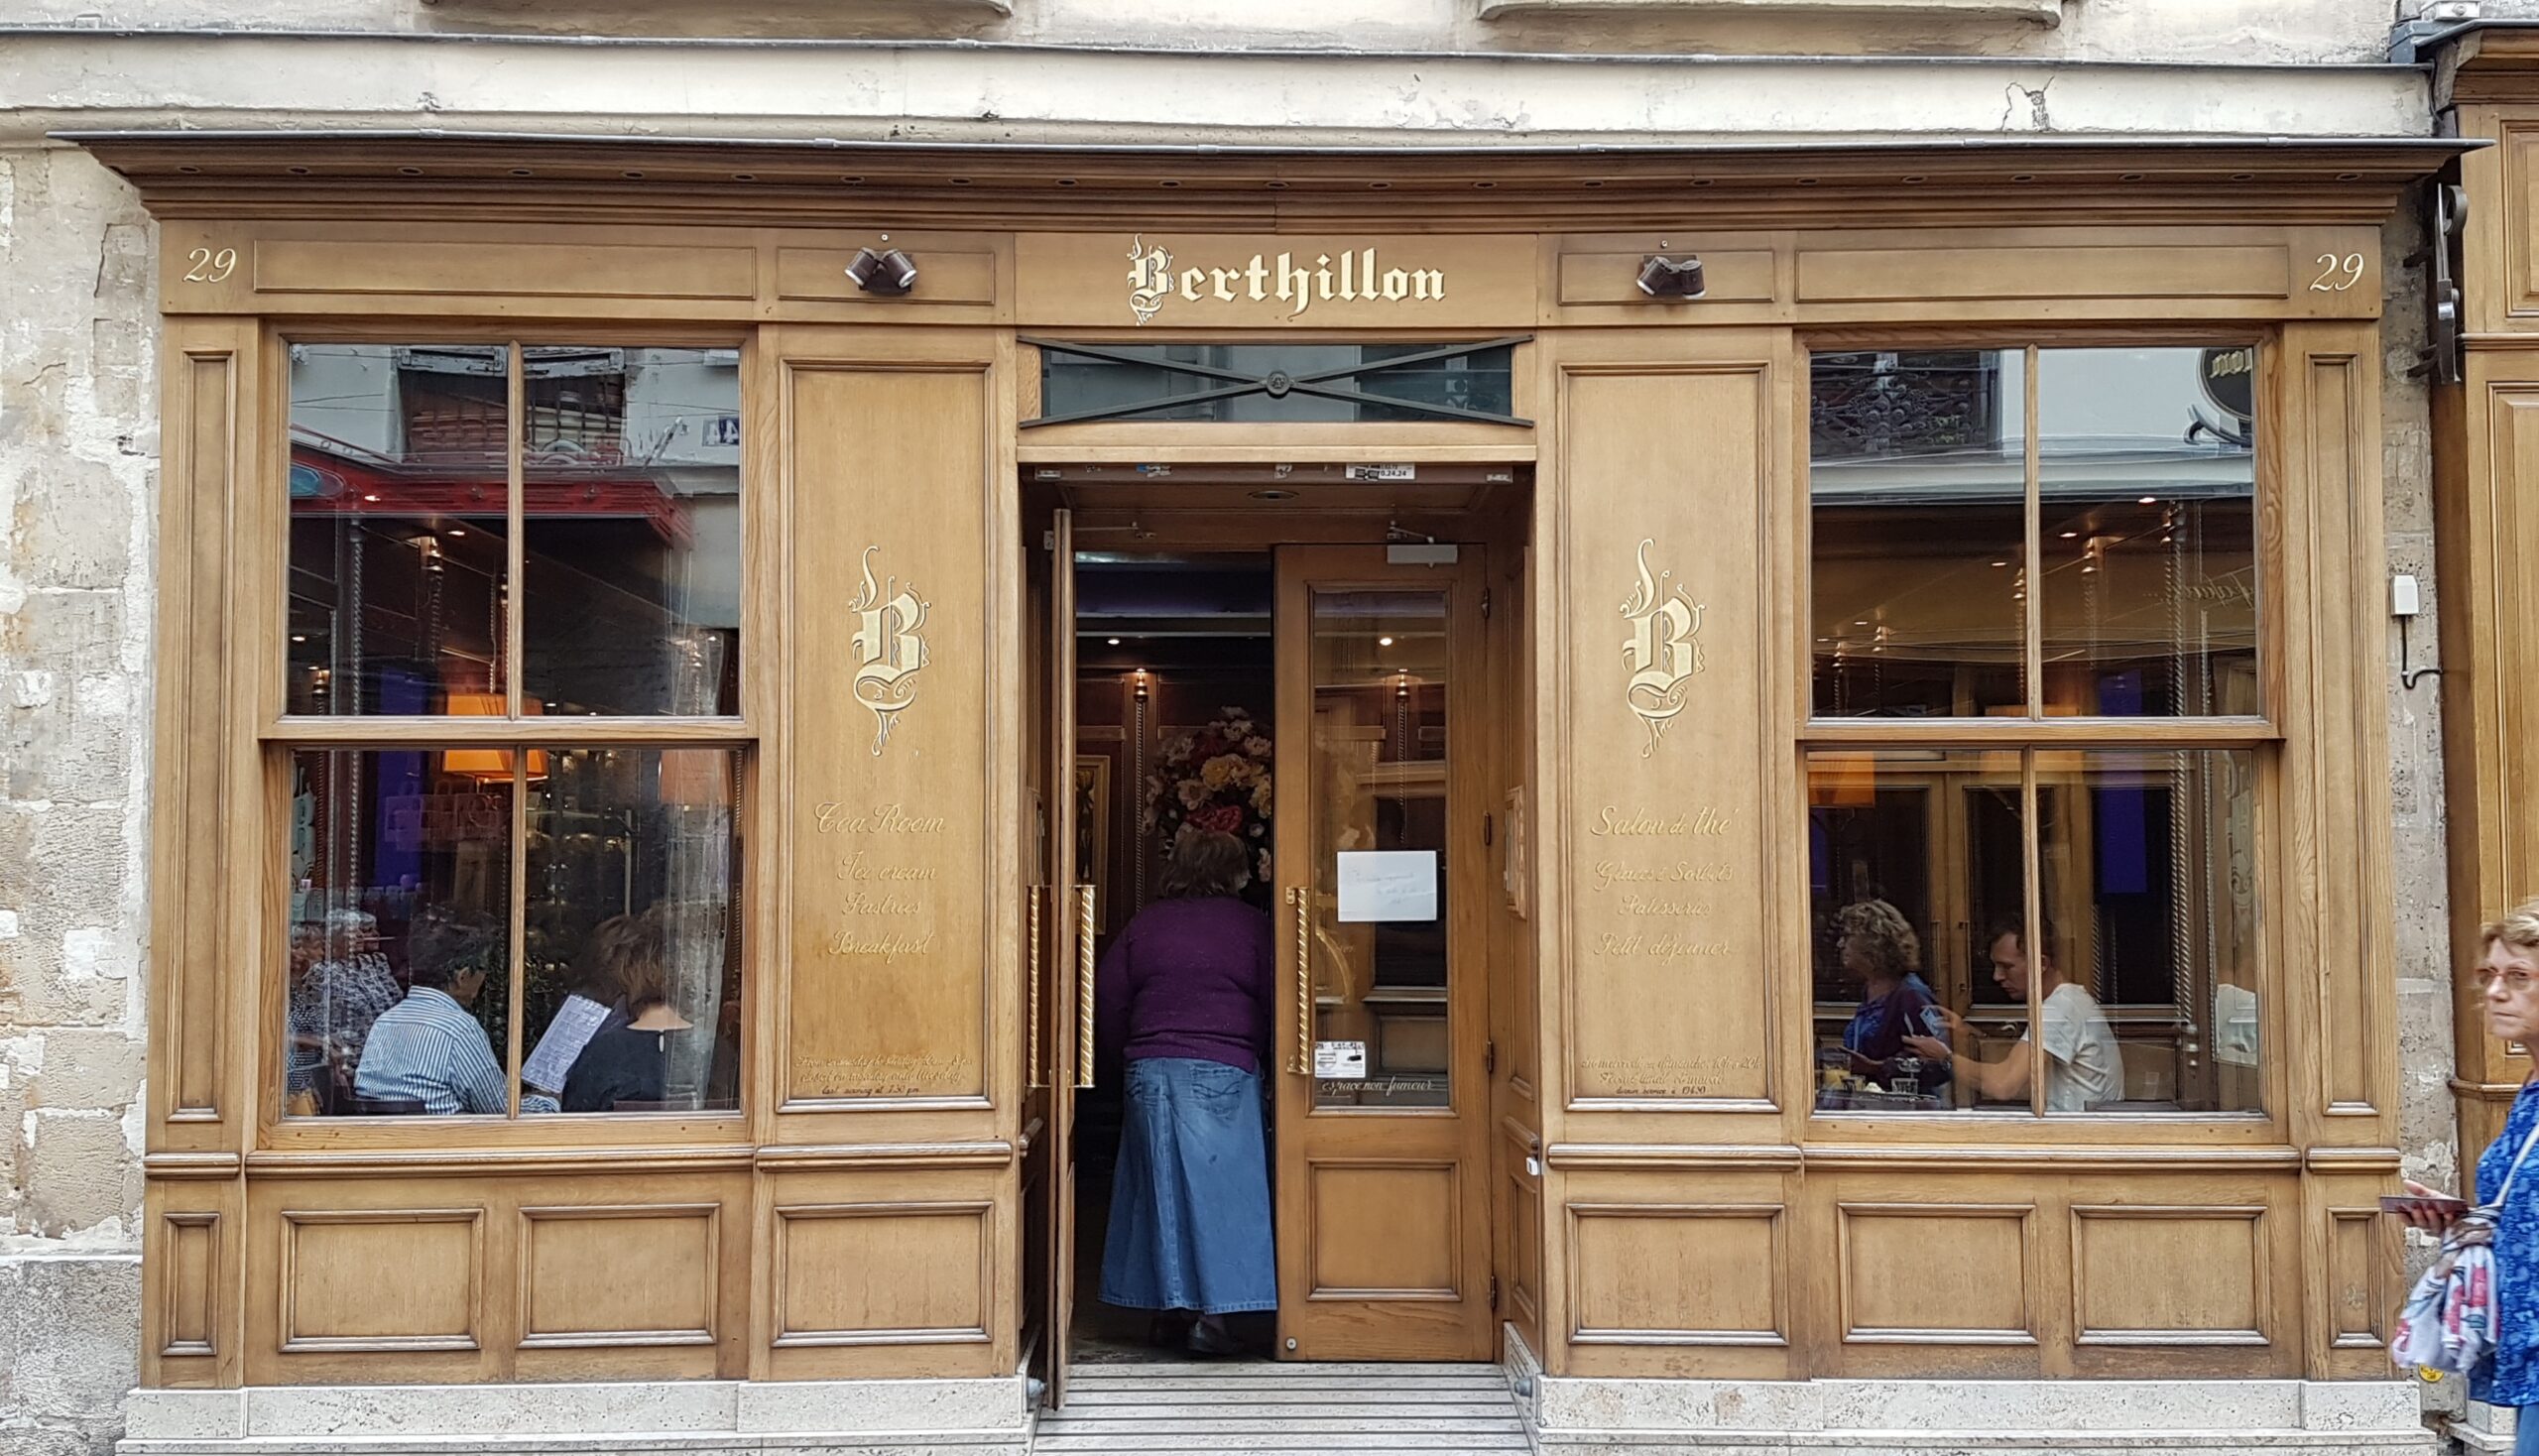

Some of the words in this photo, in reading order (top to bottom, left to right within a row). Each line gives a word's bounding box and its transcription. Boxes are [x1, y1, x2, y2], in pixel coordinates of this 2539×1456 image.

[182, 247, 236, 283] 29
[1126, 233, 1447, 326] Berthillon
[2308, 252, 2364, 292] 29
[848, 546, 932, 757] B
[1619, 538, 1707, 759] B
[814, 801, 867, 833] Tea
[868, 802, 945, 833] Room
[1590, 805, 1664, 836] Salon
[1692, 805, 1739, 836] thé
[827, 930, 935, 964] Breakfast
[1321, 1081, 1361, 1097] espace
[1363, 1081, 1384, 1091] non
[1386, 1075, 1432, 1097] fumeur
